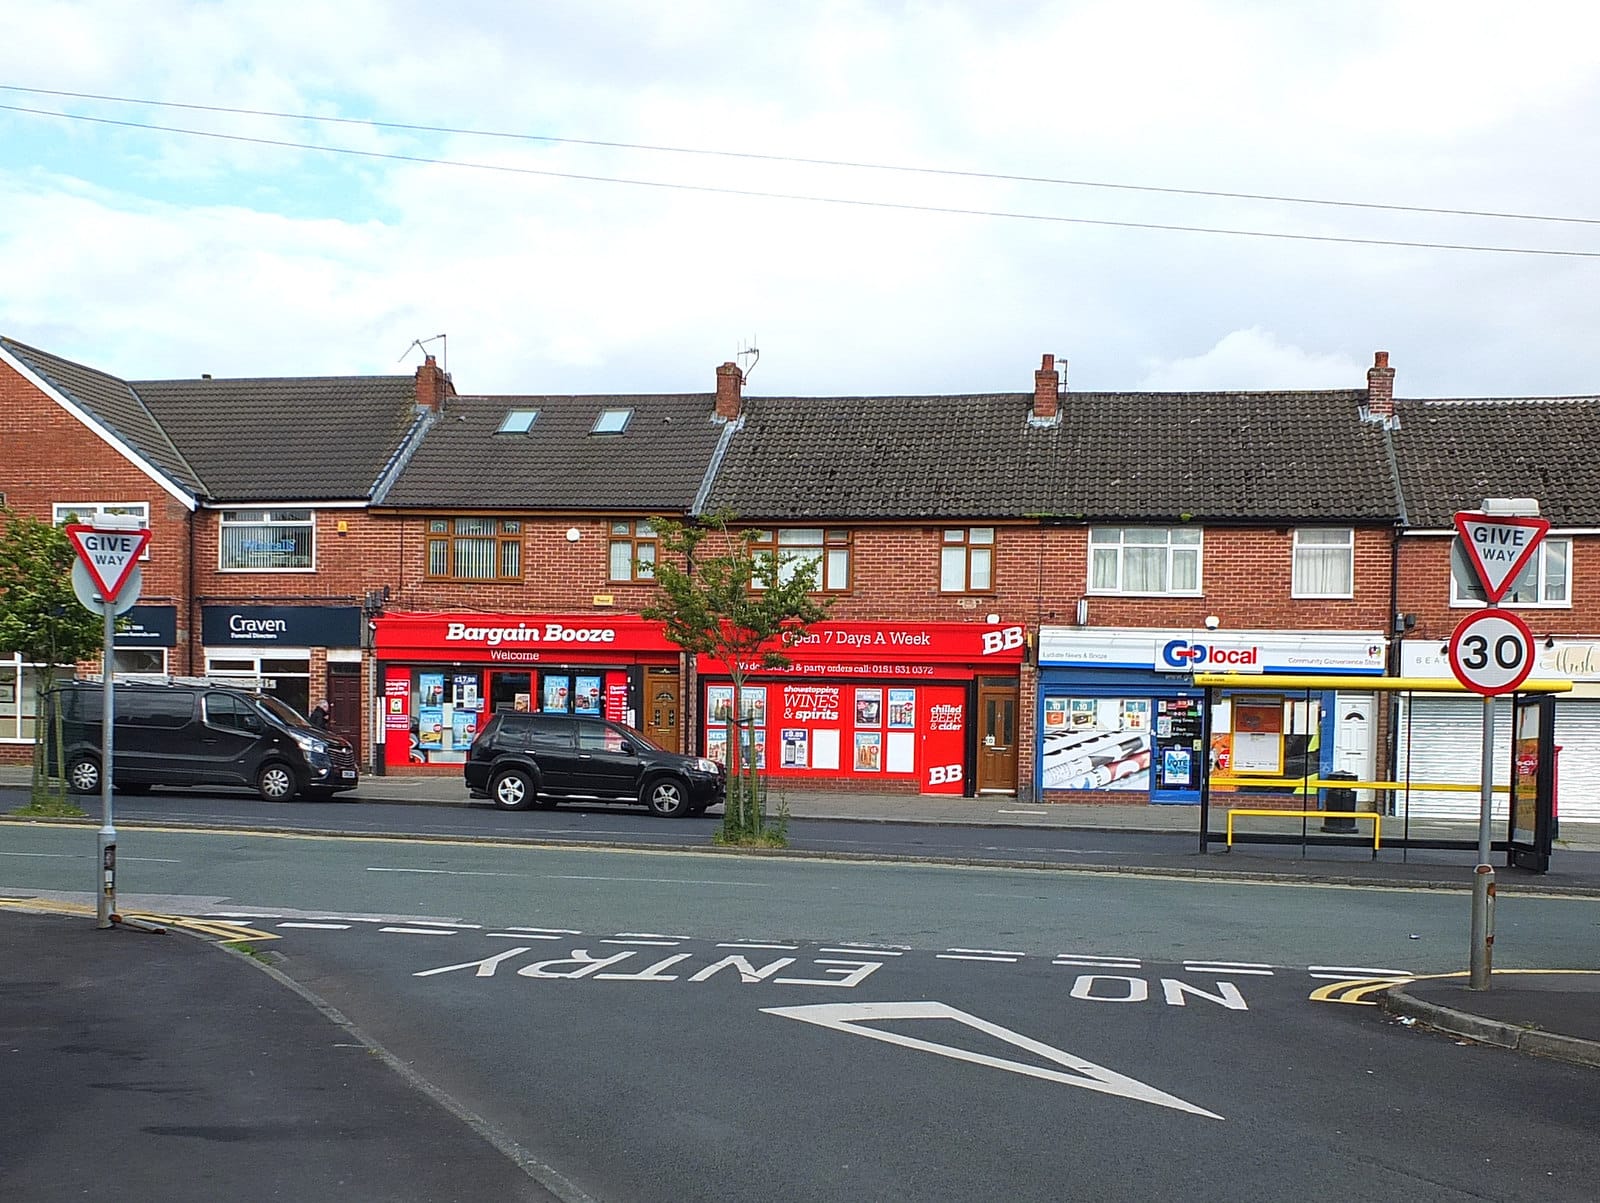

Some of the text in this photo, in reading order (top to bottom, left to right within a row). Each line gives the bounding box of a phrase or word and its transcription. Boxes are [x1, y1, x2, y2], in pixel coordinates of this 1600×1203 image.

[1473, 526, 1525, 547] GIVE
[85, 536, 132, 552] GIVE
[95, 554, 125, 565] WAY
[1482, 548, 1516, 562] WAY
[230, 614, 287, 632] Craven
[445, 623, 615, 646] Bargain Booze
[824, 631, 833, 644] 7
[836, 631, 872, 648] Days
[873, 631, 886, 645] A
[888, 631, 931, 645] Week
[981, 626, 1024, 655] BB
[490, 650, 540, 661] Welcome
[1209, 645, 1257, 665] local
[1462, 635, 1523, 670] 30
[1288, 657, 1323, 665] Community
[796, 663, 802, 672] &
[803, 663, 826, 674] party
[827, 663, 853, 673] orders
[854, 663, 871, 673] call:
[783, 685, 839, 695] showstopping
[783, 693, 839, 708] WINES
[783, 708, 839, 722] & spirits
[930, 704, 962, 713] chilled
[929, 713, 962, 723] BEER
[930, 722, 962, 731] & cider
[1167, 758, 1188, 768] VOTE
[928, 764, 963, 786] BB
[411, 947, 1249, 1011] NO ENTRY
